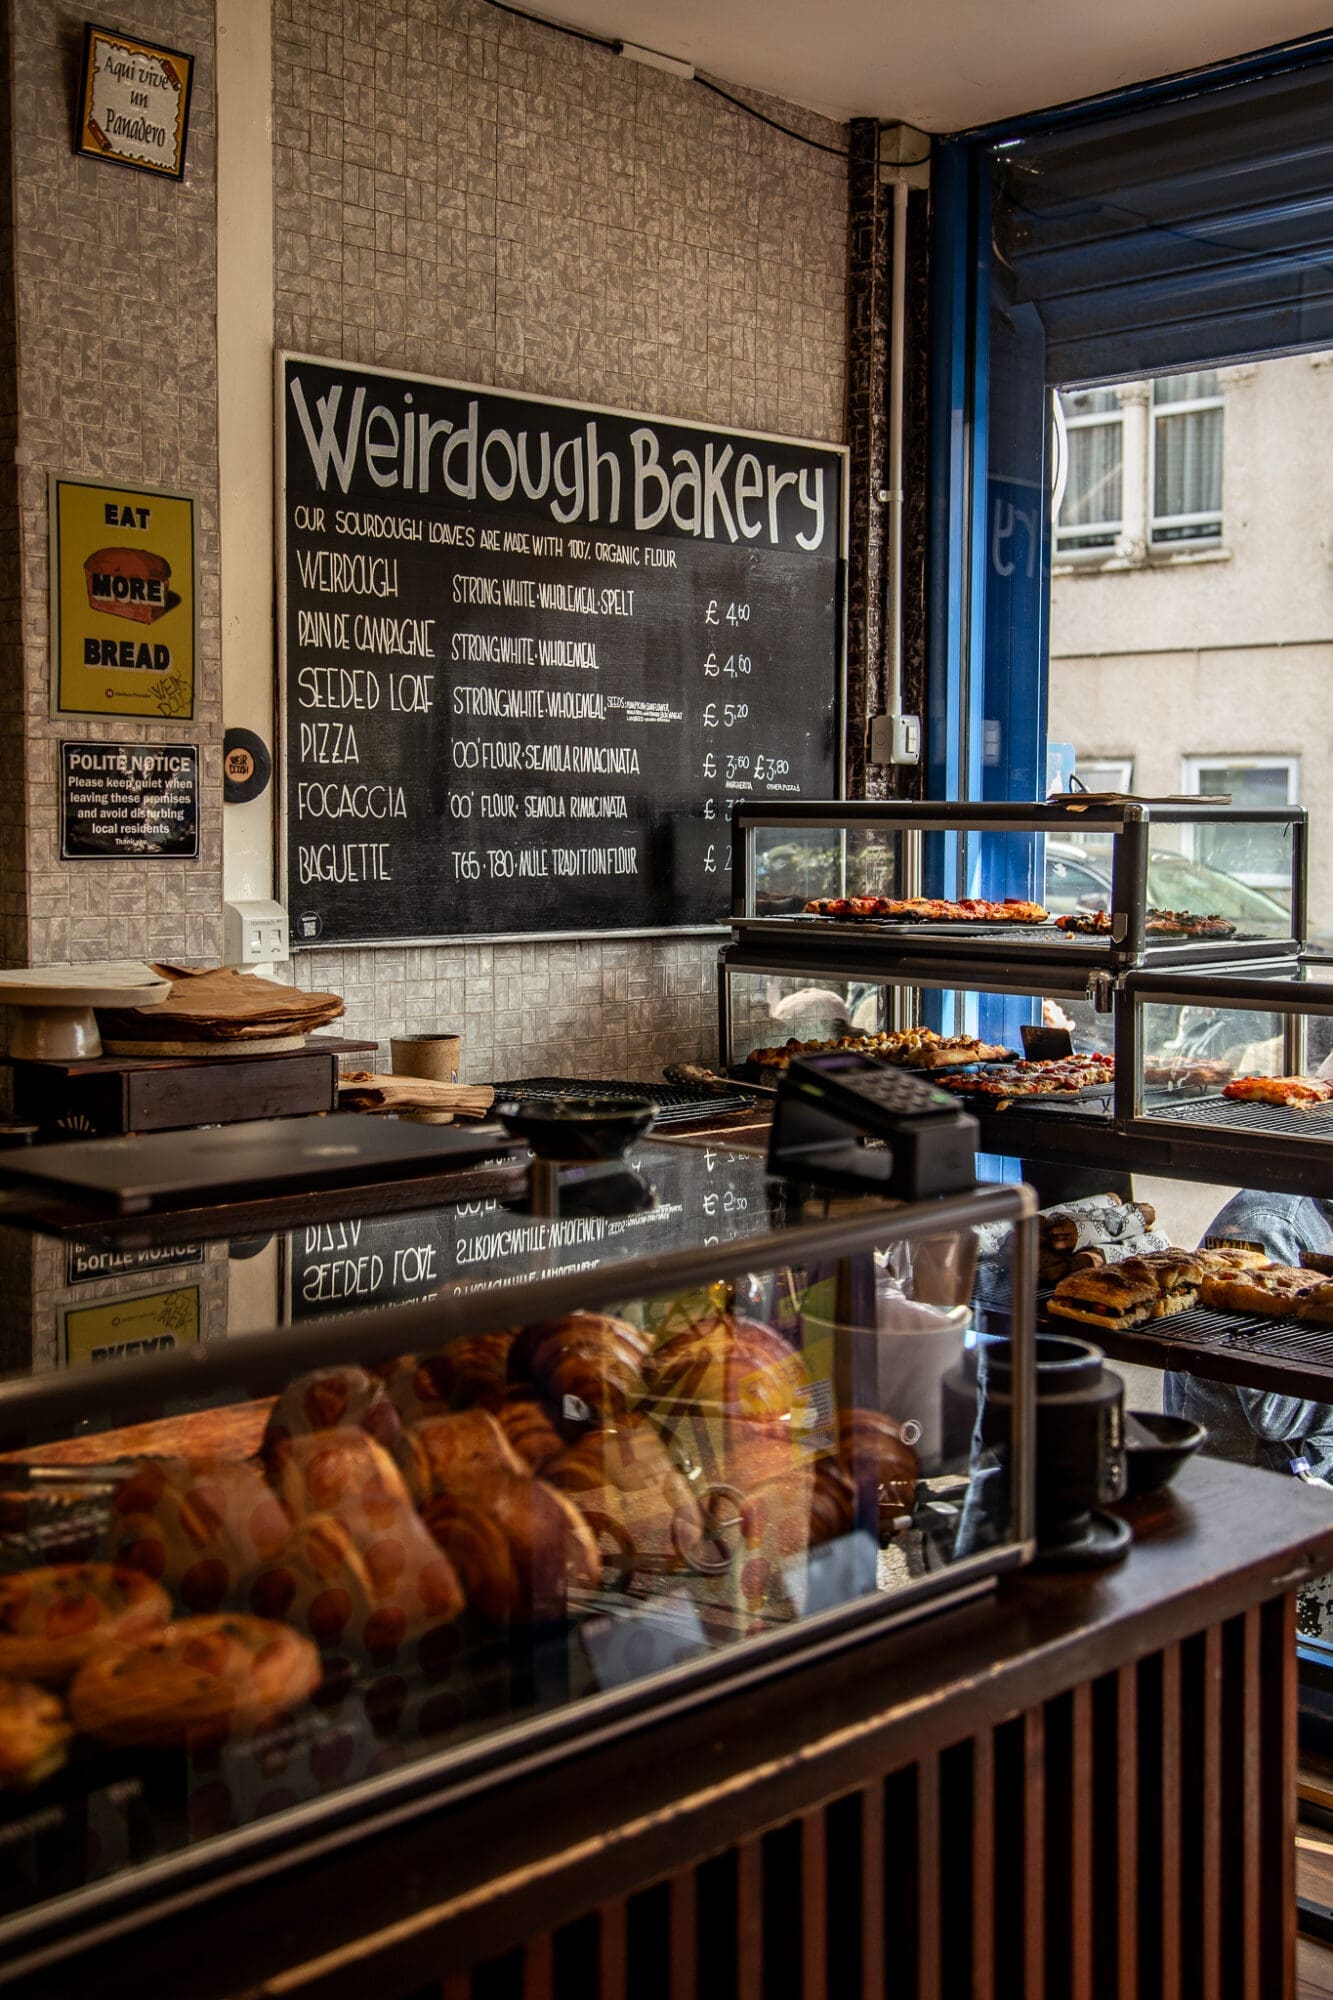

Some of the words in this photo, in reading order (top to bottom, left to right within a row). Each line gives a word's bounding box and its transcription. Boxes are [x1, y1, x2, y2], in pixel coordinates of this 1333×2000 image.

[104, 56, 135, 83] Aqui
[138, 66, 169, 90] vive
[130, 90, 148, 108] un
[105, 108, 166, 147] Panadero
[290, 377, 620, 524] Weirdough
[104, 503, 150, 530] EAT
[295, 506, 326, 533] OUR
[335, 510, 422, 541] SOURDOUGH
[429, 521, 475, 547] LOAVES
[480, 529, 501, 551] ARE
[503, 532, 530, 554] MADE
[532, 535, 563, 557] WITH
[568, 539, 591, 562] 100%
[595, 542, 640, 566] ORGANIC
[644, 548, 677, 568] FLOUR
[92, 572, 163, 604] MORE
[297, 550, 398, 597] WEIRDOUGH
[452, 574, 501, 605] STRONG
[502, 579, 535, 609] WHITE
[298, 610, 331, 648] PAIN
[334, 613, 350, 650] DE
[354, 615, 435, 657] CAMPAGNE
[84, 638, 170, 670] BREAD
[539, 639, 599, 669] WHOLEMEAL
[298, 667, 380, 709] SEEDED
[389, 673, 434, 713] LOAF
[300, 722, 359, 764] PIZZA
[482, 741, 522, 770] FLOUR
[525, 744, 571, 772] SEMOLA
[572, 746, 640, 775] RIMACINATA
[70, 754, 127, 771] POLITE
[132, 756, 190, 772] NOTICE
[68, 776, 104, 787] Please
[106, 777, 132, 790] keep
[135, 778, 162, 790] quiet
[165, 779, 193, 789] when
[70, 792, 108, 805] leaving
[111, 793, 140, 803] these
[143, 793, 191, 805] premises
[78, 808, 97, 818] and
[100, 808, 127, 818] avoid
[131, 808, 184, 821] disturbing
[298, 782, 407, 820] FOCACCIA
[481, 793, 516, 818] FLOUR
[524, 795, 565, 818] SEMOLA
[570, 796, 628, 819] RIMACINATA
[92, 824, 117, 833] local
[120, 824, 170, 834] residents
[299, 843, 392, 884] BAGUETTE
[451, 851, 480, 880] T65
[486, 850, 513, 878] T80
[551, 847, 607, 876] TRADITION
[608, 846, 638, 874] FLOUR
